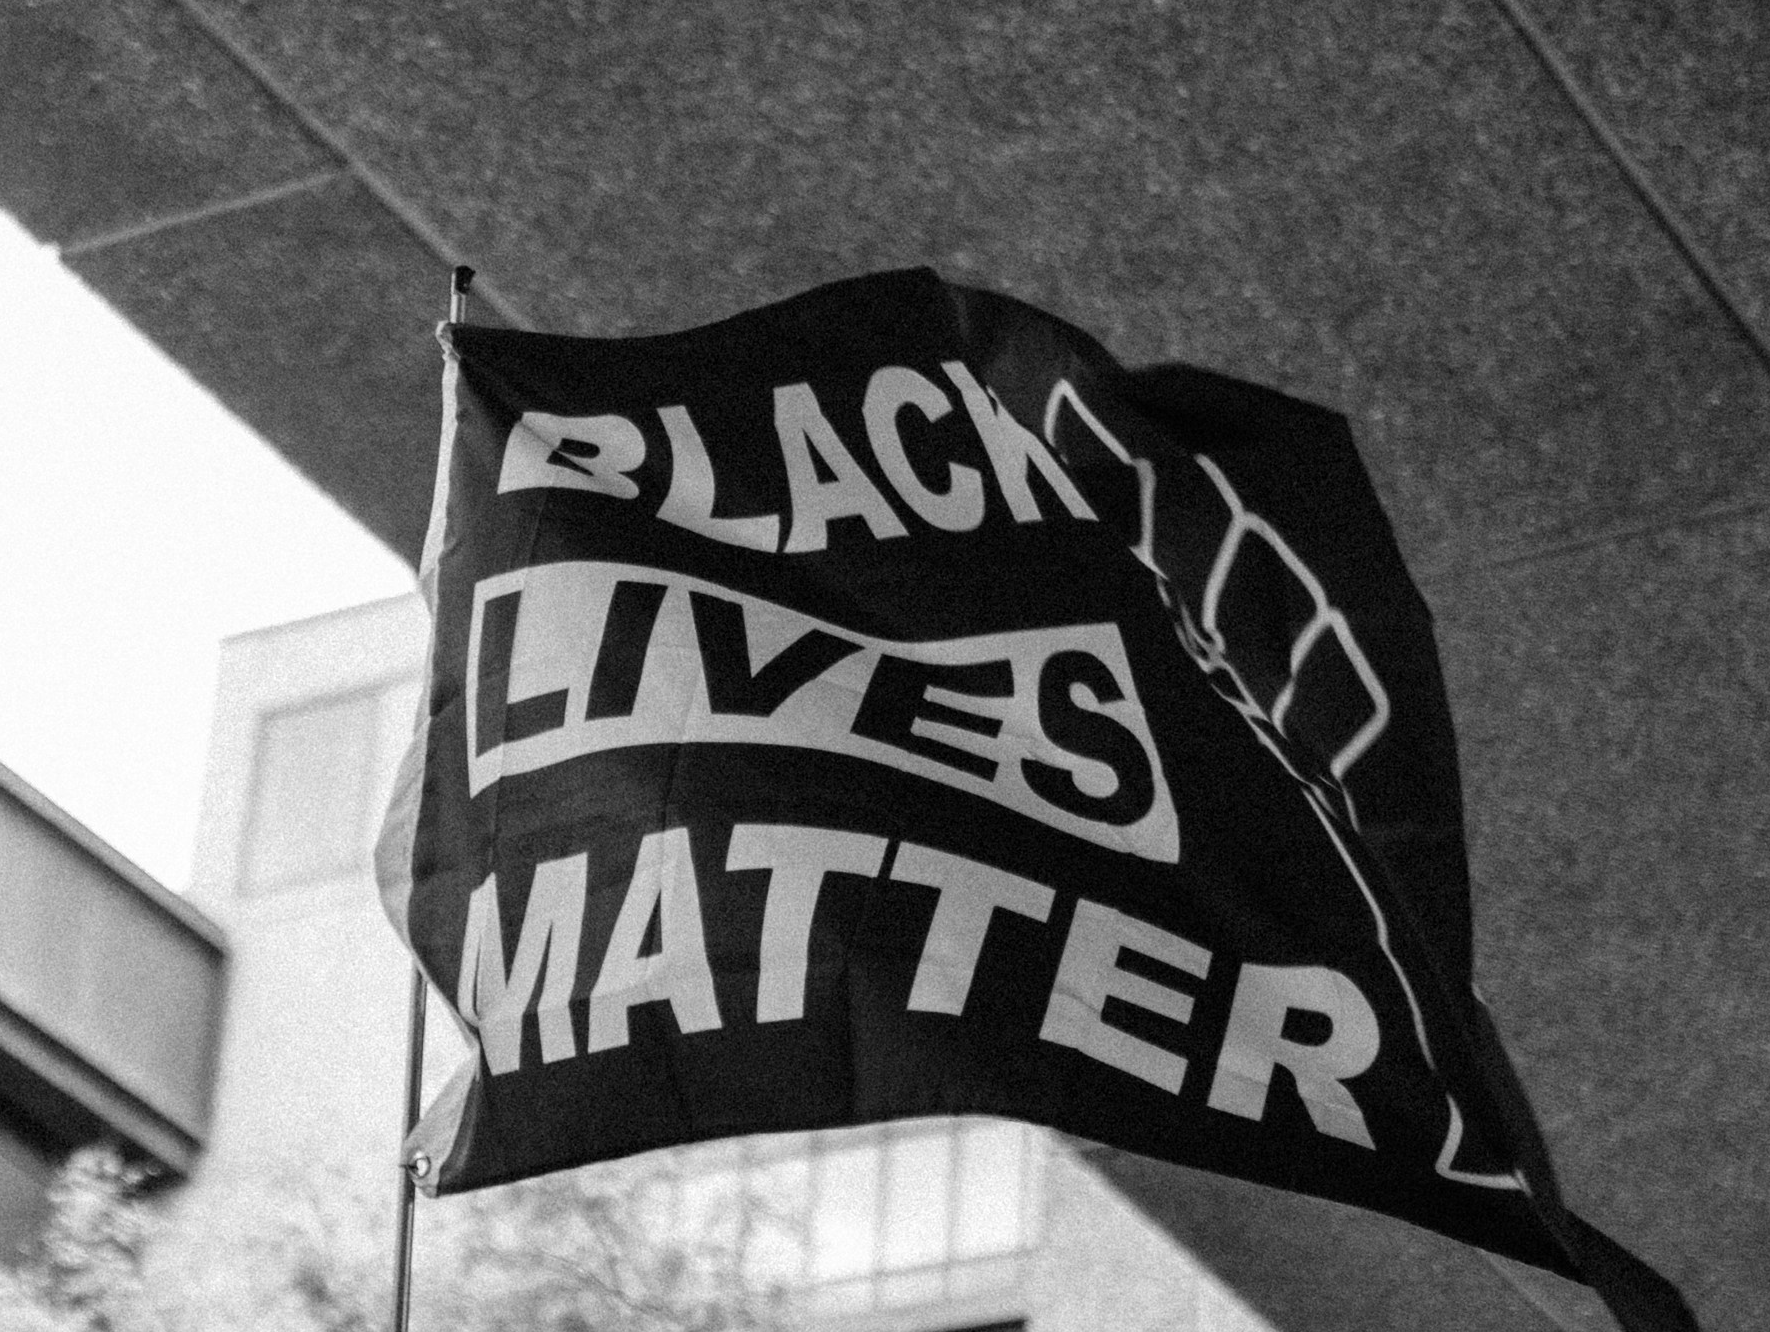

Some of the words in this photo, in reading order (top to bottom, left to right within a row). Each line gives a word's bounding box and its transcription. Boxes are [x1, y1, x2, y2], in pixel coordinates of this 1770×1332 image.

[494, 359, 1099, 554] BLACK
[475, 578, 1157, 829] LIVES
[457, 822, 1381, 1150] MATTER
